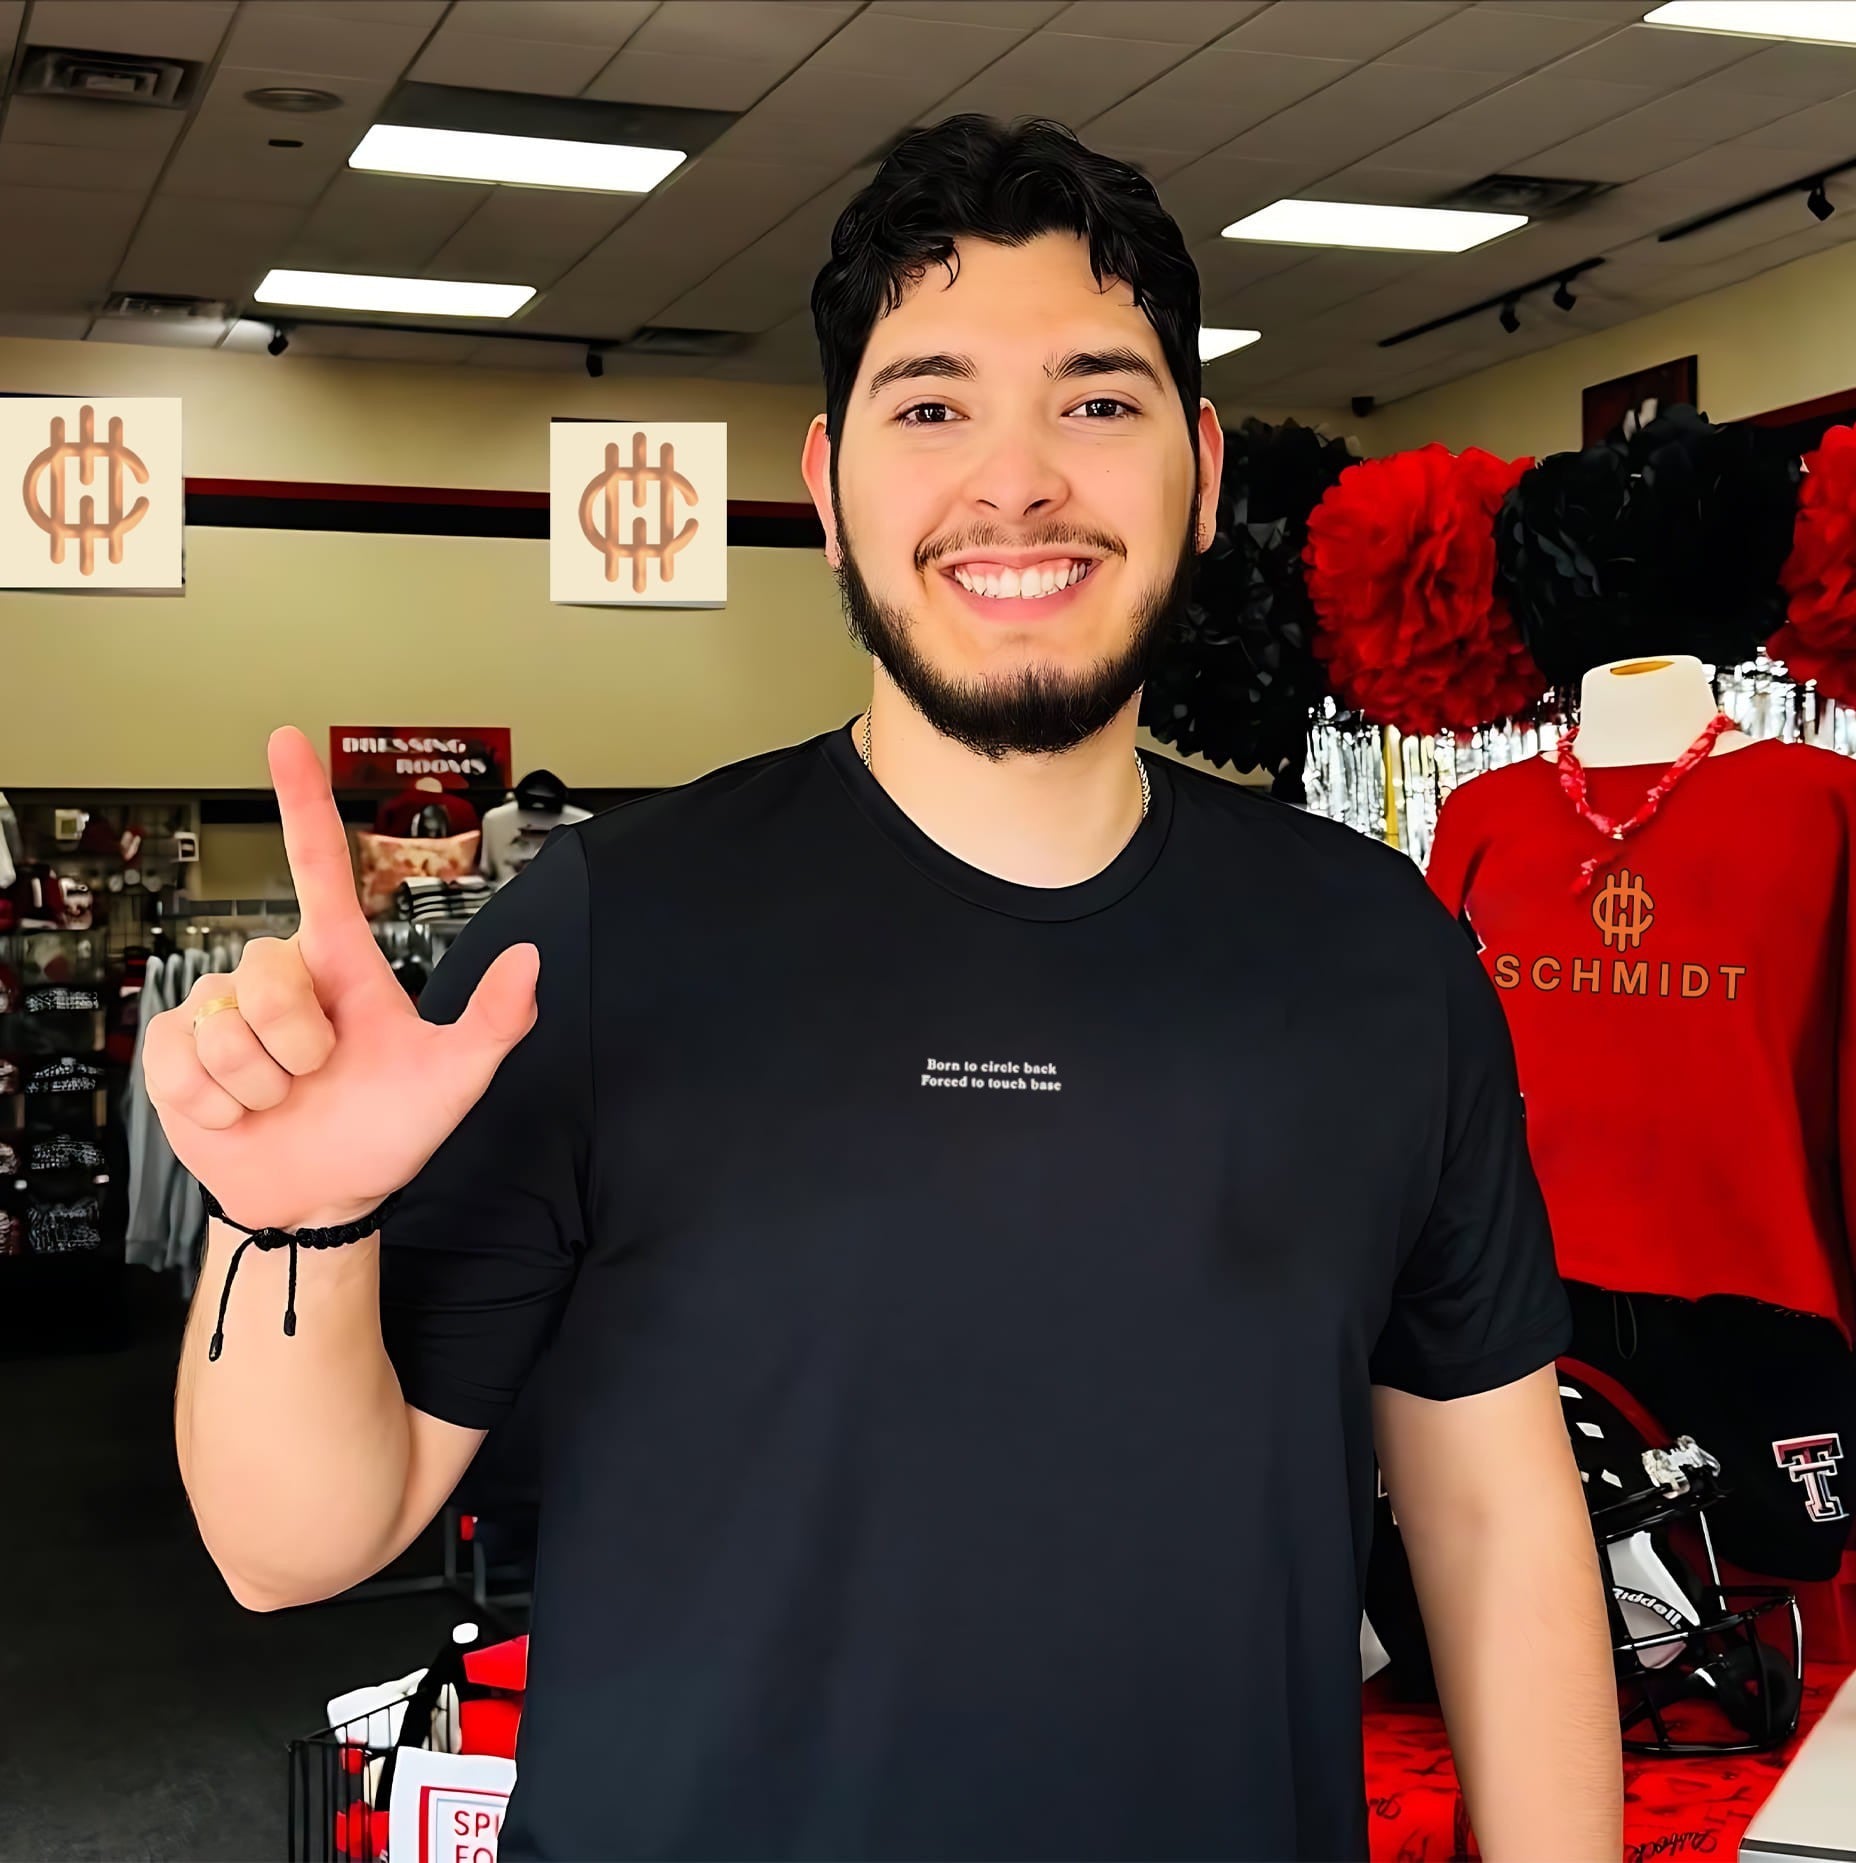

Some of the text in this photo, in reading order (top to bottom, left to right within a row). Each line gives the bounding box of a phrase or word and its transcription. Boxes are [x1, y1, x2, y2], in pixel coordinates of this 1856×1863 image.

[396, 758, 487, 775] ROOMS
[1494, 953, 1747, 1000] SCHMIDT
[927, 1058, 1057, 1075] Born to circle back
[921, 1074, 1062, 1092] Forced to touch base
